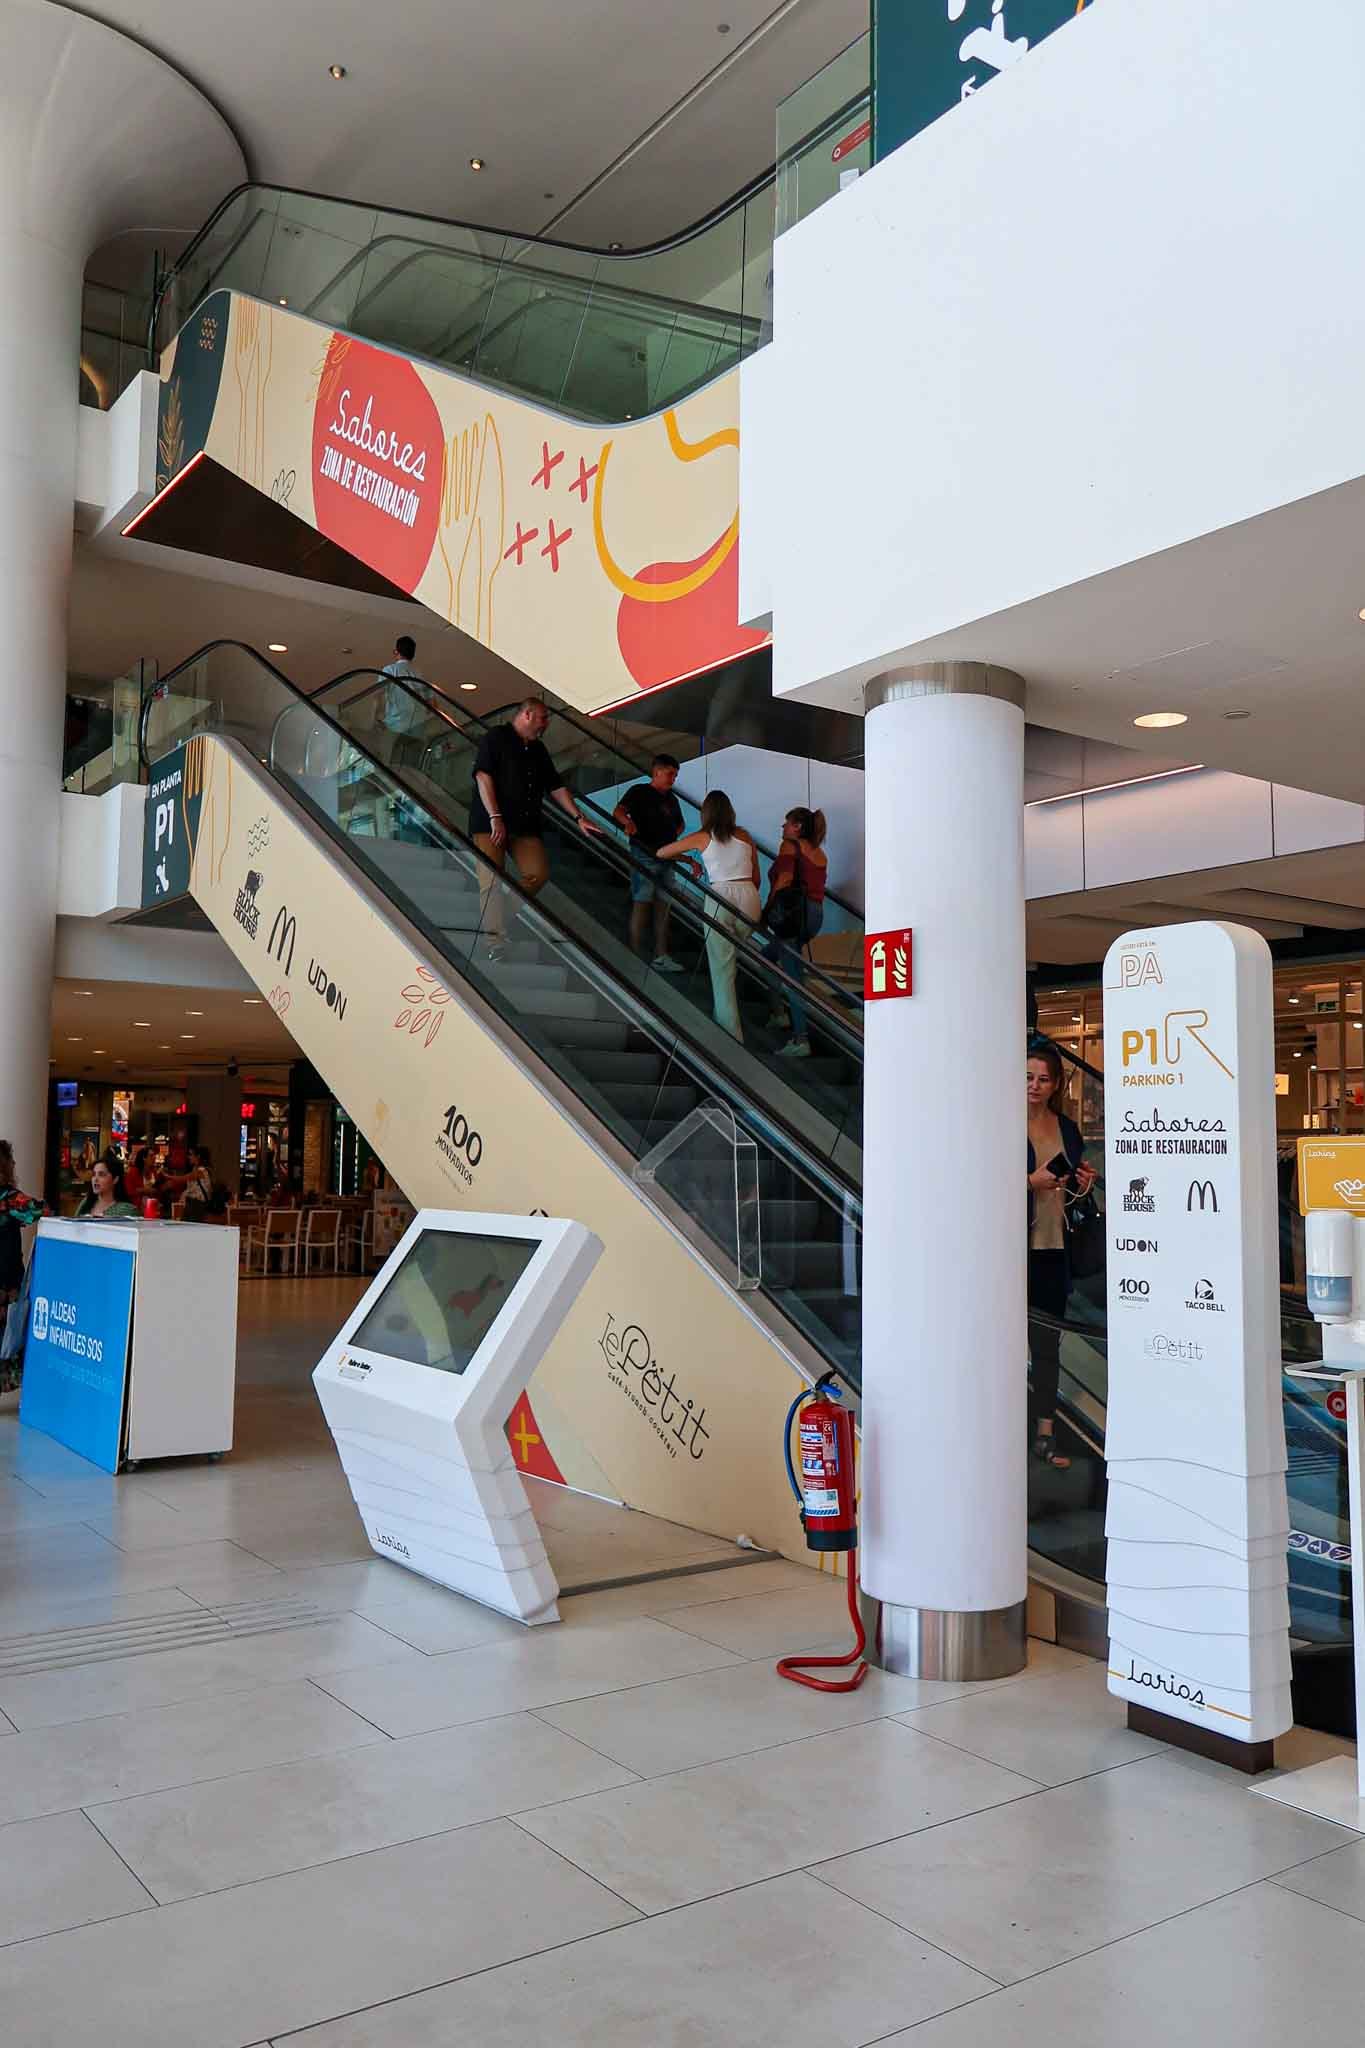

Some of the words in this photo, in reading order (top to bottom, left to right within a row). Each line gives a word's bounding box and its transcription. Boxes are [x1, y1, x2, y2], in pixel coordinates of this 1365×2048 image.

[329, 389, 426, 482] Sabores
[320, 446, 343, 482] ZONA
[341, 457, 356, 489] DE
[352, 463, 420, 528] RESTAURACIÓN
[151, 782, 160, 799] EN
[159, 769, 182, 794] PLANTA
[155, 799, 175, 852] P1
[236, 887, 260, 920] BLOCK
[233, 903, 258, 940] HOUSE
[1120, 951, 1163, 987] PA
[1122, 1028, 1158, 1067] P1
[1122, 1073, 1175, 1087] PARKING
[1178, 1072, 1184, 1085] 1
[443, 1105, 482, 1167] 100
[1120, 1107, 1227, 1132] Sabores
[435, 1135, 472, 1185] MONTADITOS
[1115, 1139, 1138, 1154] ZONA
[1141, 1139, 1152, 1154] DE
[1156, 1139, 1227, 1154] RESTAURACION
[1123, 1194, 1155, 1204] BLOCK
[1123, 1203, 1155, 1212] HOUSE
[1116, 1238, 1158, 1253] UDON
[1118, 1278, 1150, 1295] 100
[50, 1300, 76, 1326] ALDEAS
[1185, 1301, 1205, 1310] TACO
[1206, 1302, 1225, 1312] BELL
[49, 1325, 87, 1356] INFANTILES
[86, 1338, 103, 1362] SOS
[1127, 1659, 1206, 1706] Larios
